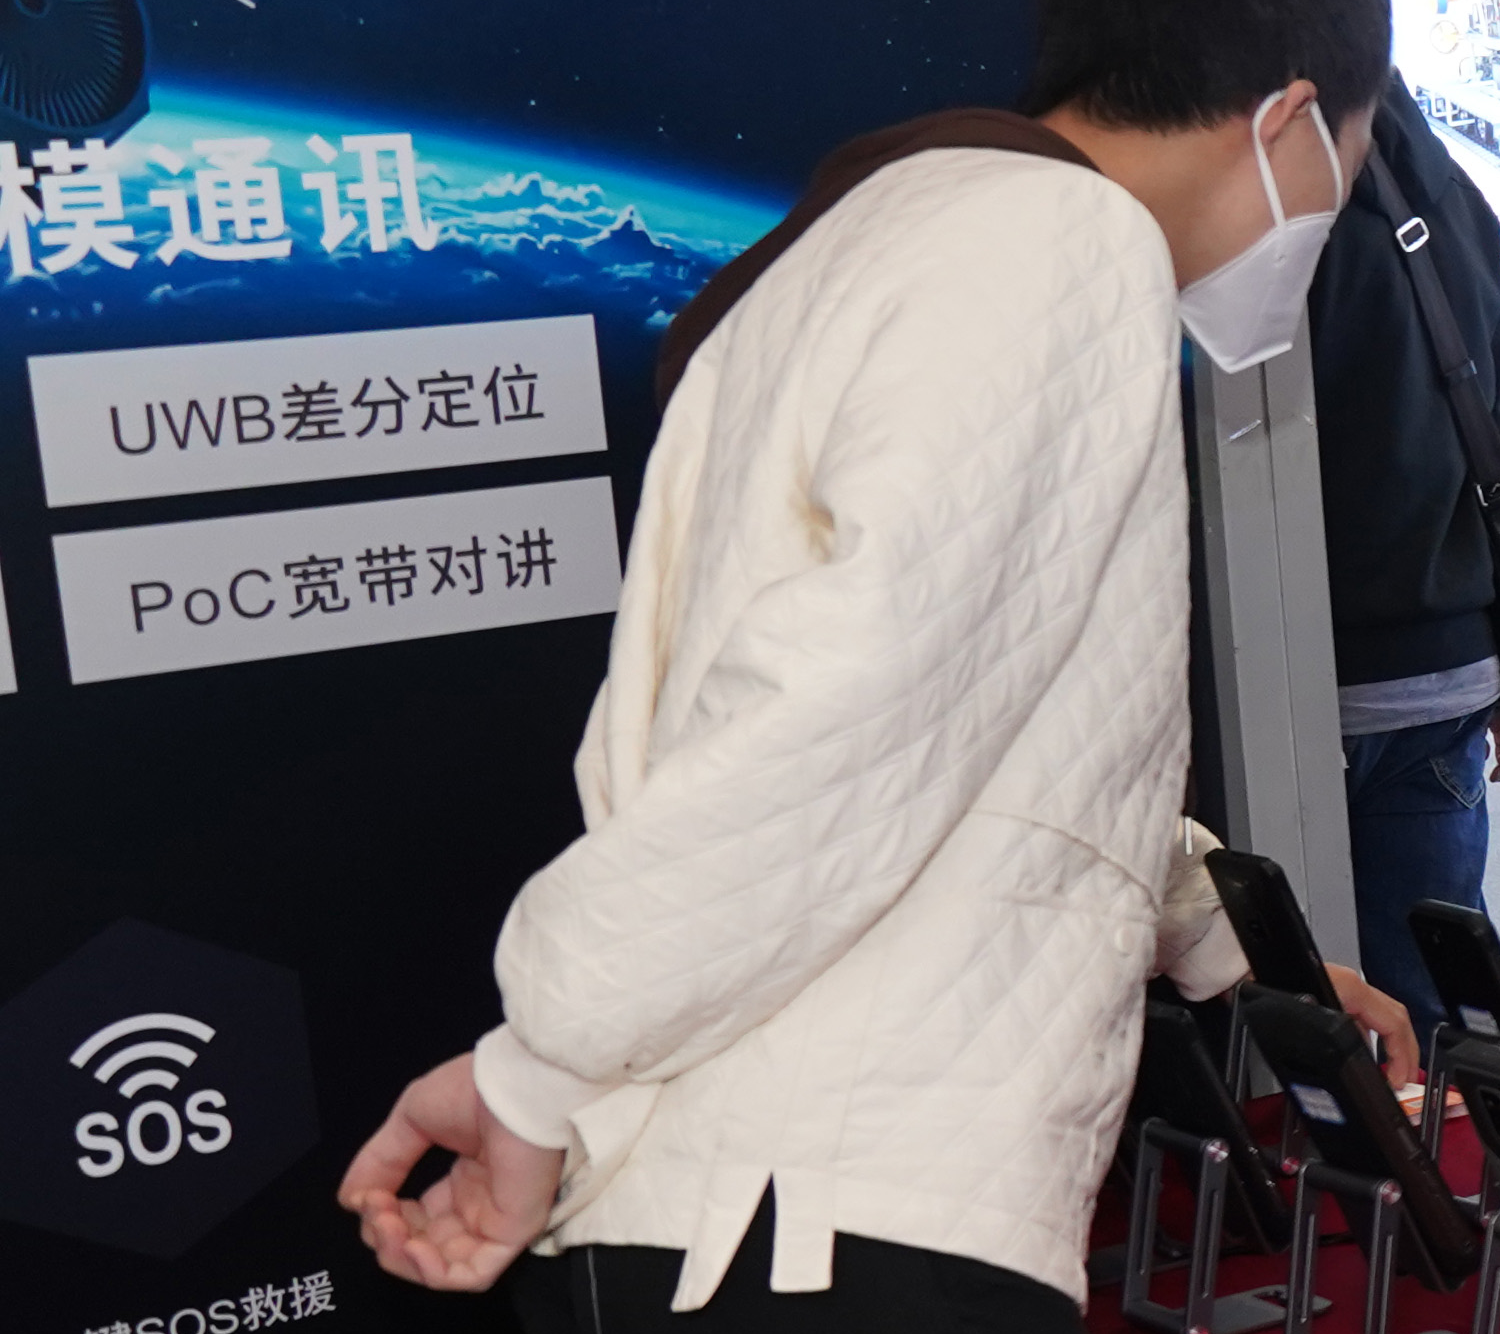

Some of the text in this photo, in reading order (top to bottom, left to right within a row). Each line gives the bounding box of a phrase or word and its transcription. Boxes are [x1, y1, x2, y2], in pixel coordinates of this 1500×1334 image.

[109, 363, 546, 456] UWB差分定位
[129, 527, 559, 634] PoC宽带对讲
[74, 1087, 233, 1179] SOS
